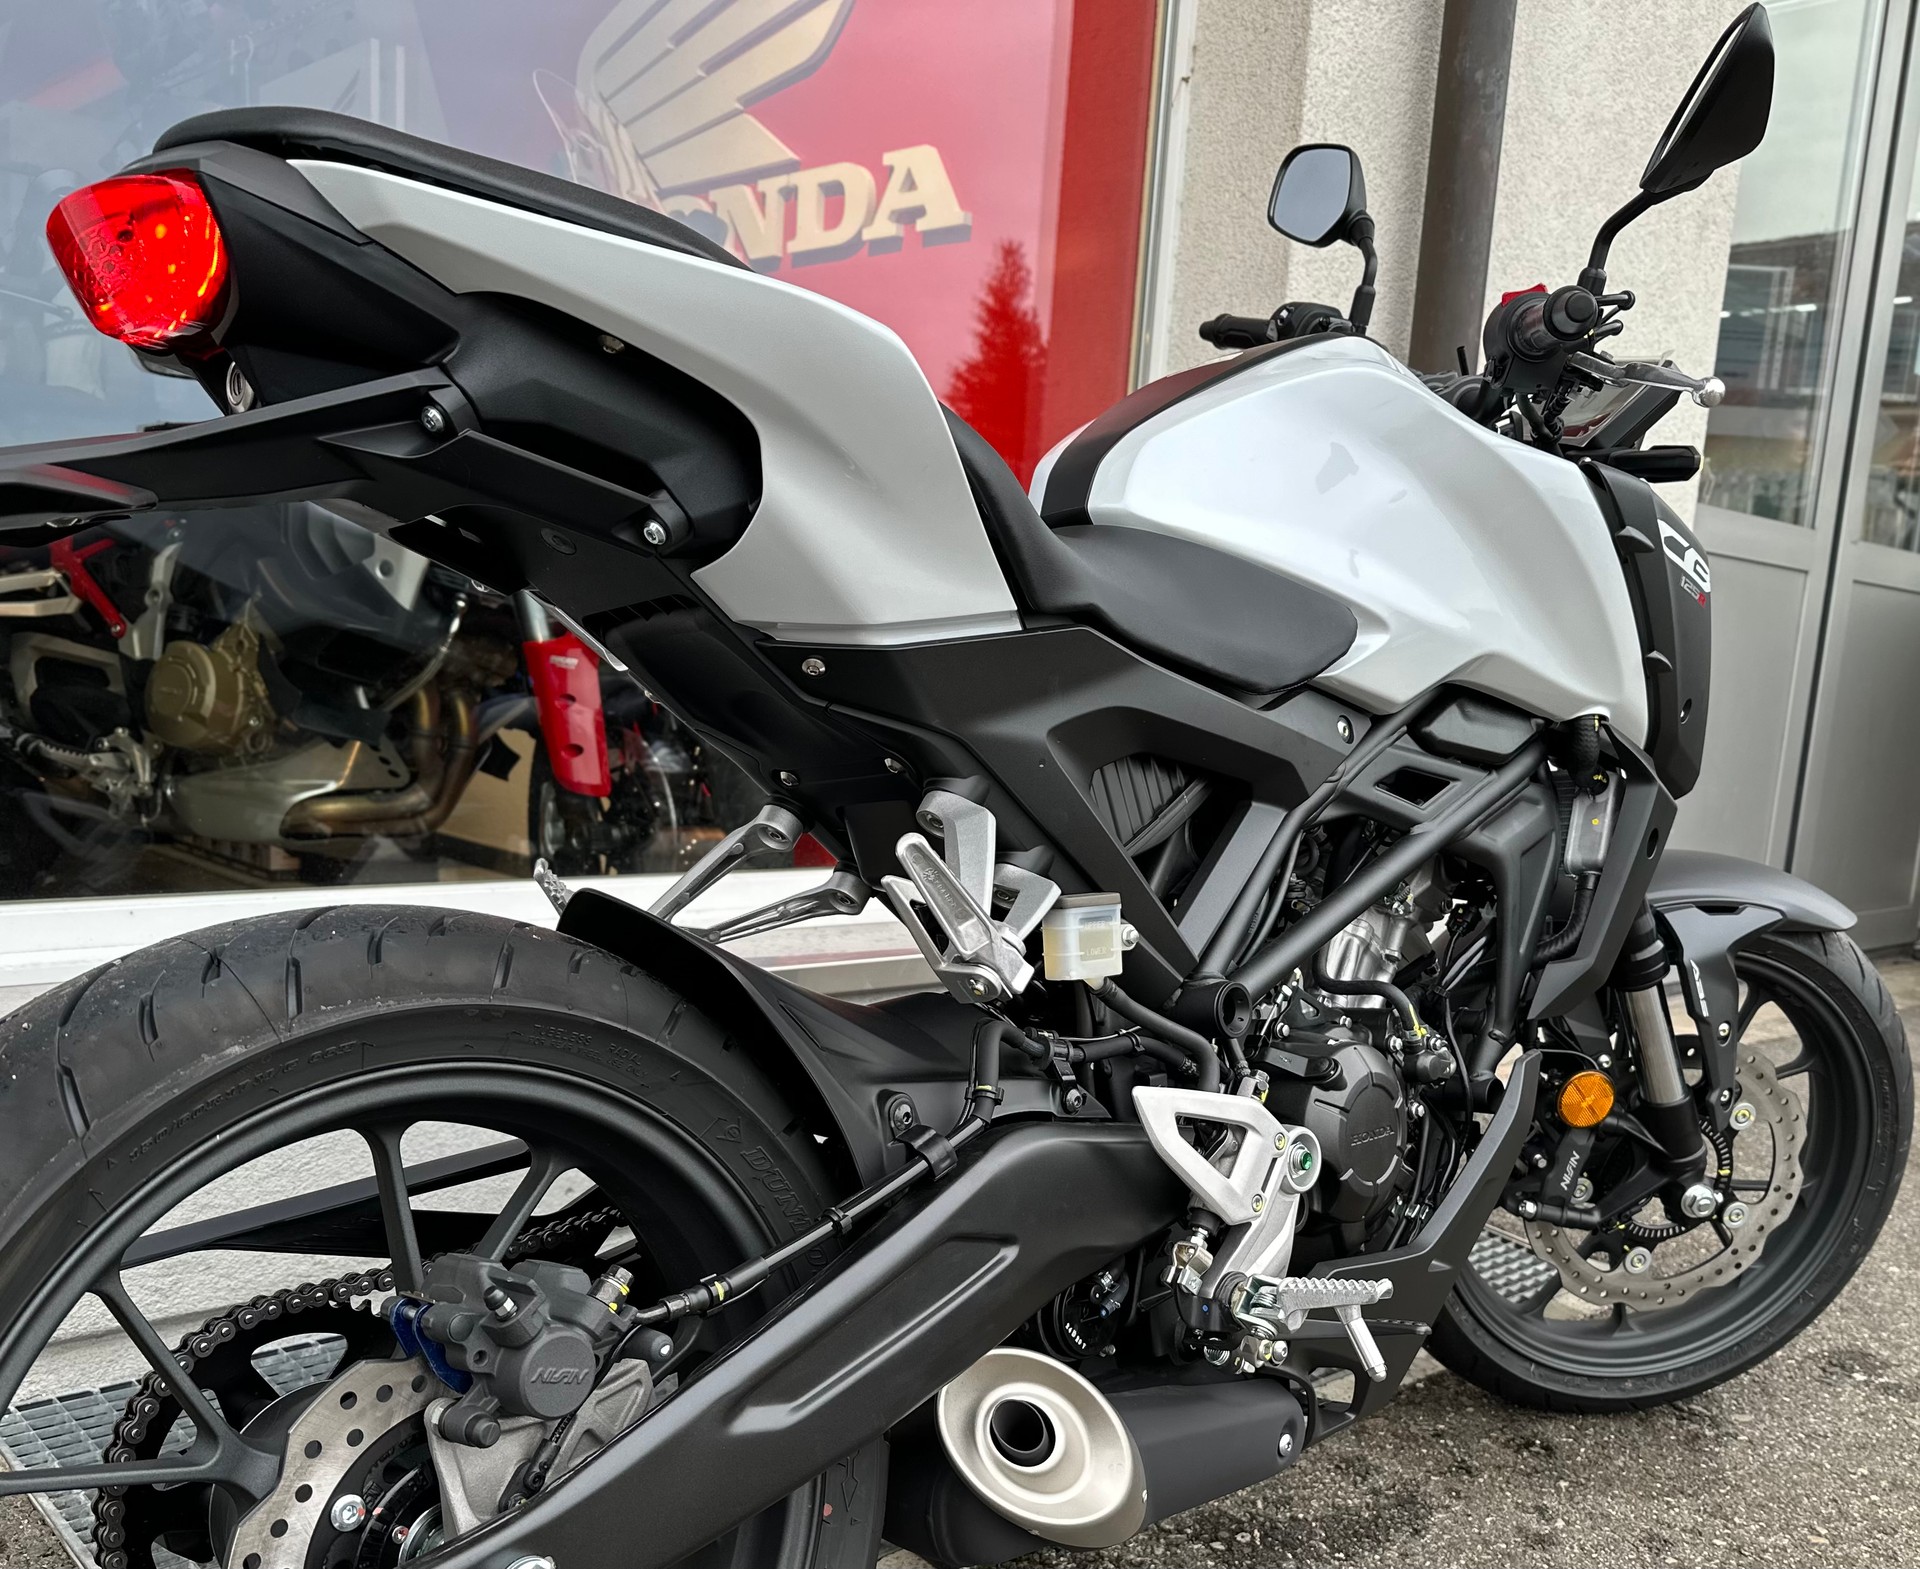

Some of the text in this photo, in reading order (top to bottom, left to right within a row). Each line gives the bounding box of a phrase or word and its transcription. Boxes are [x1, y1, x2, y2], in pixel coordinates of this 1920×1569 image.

[1656, 518, 1712, 593] CB
[1680, 574, 1707, 608] 125R
[1086, 948, 1107, 957] LOWER
[1350, 1125, 1396, 1147] HONDA
